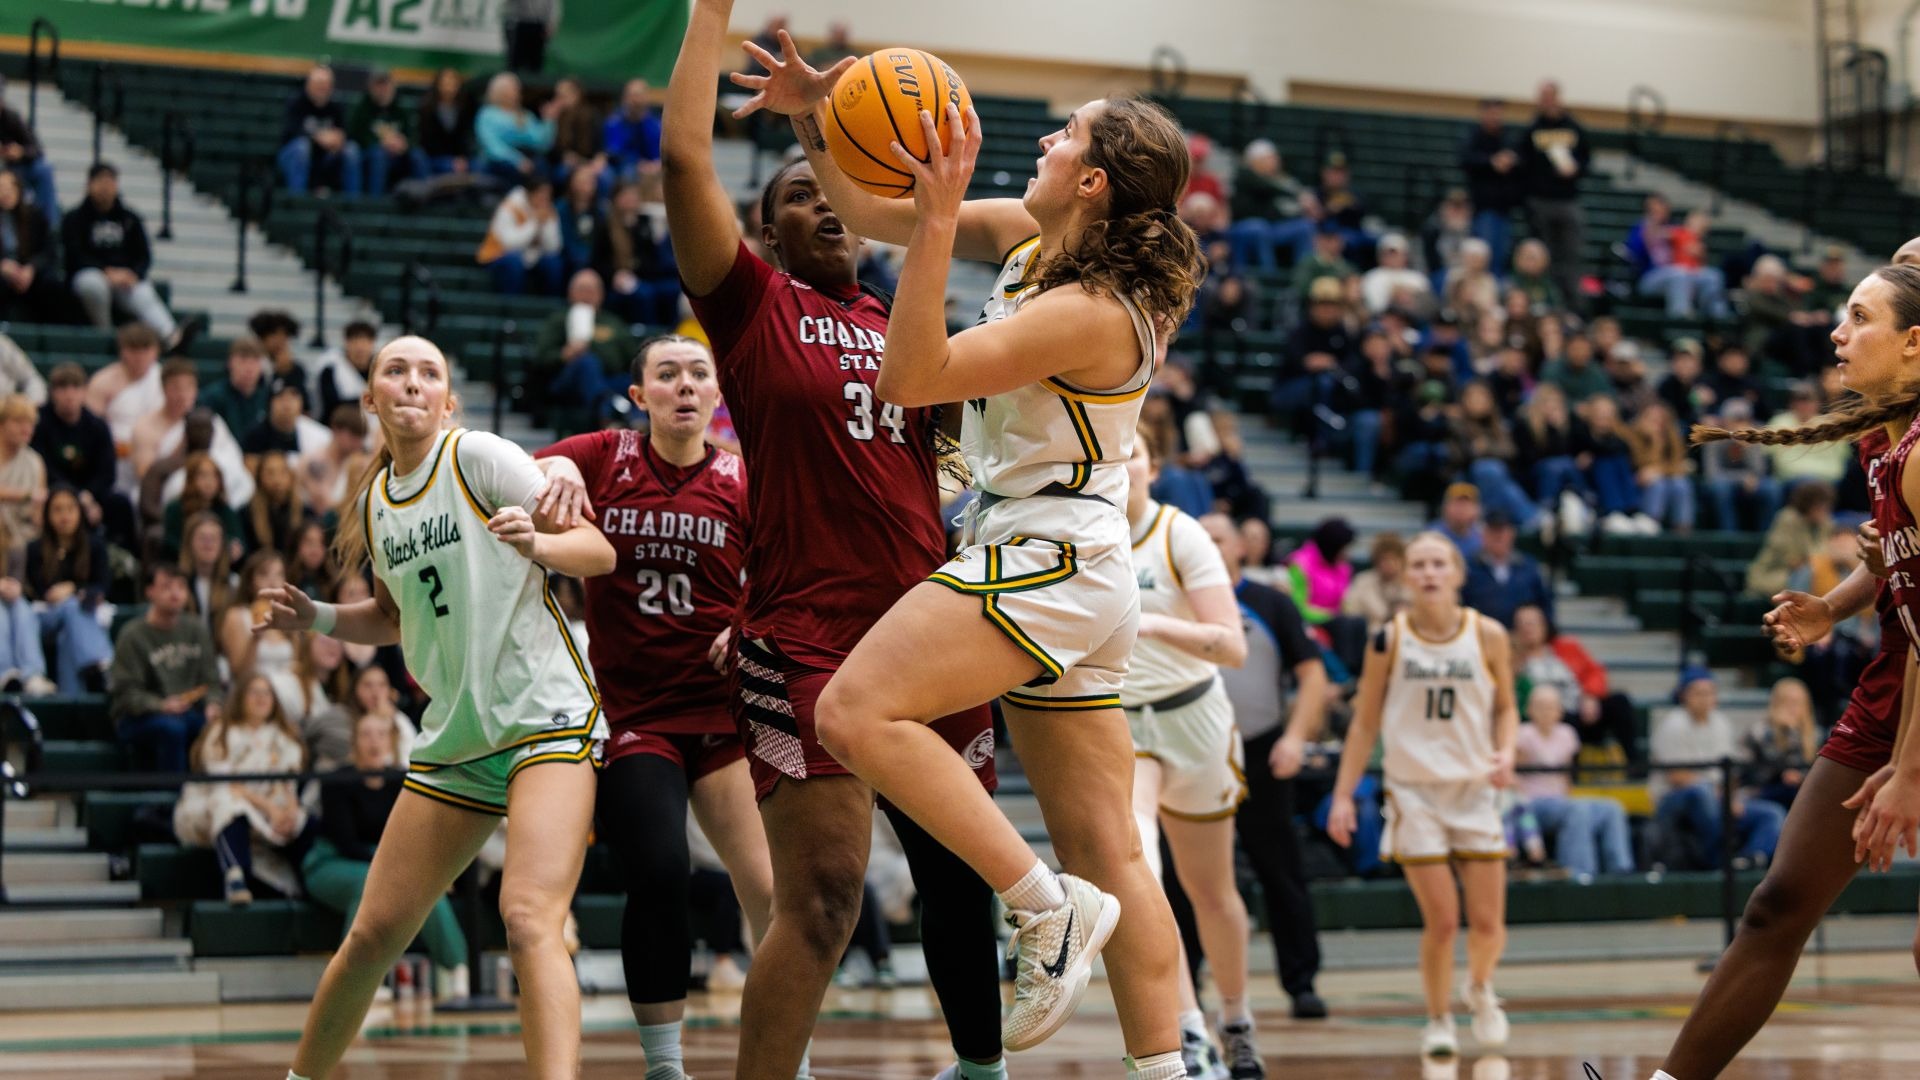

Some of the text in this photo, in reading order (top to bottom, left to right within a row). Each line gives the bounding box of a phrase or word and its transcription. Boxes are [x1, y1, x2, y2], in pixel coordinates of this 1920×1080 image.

[799, 315, 885, 353] CHADR
[839, 353, 882, 370] STA
[843, 381, 906, 443] 34
[383, 513, 461, 570] Black Hills
[603, 507, 728, 548] CHADRON
[635, 543, 697, 566] STATE
[418, 565, 450, 618] 2
[637, 569, 695, 615] 20
[1426, 687, 1454, 720] 10
